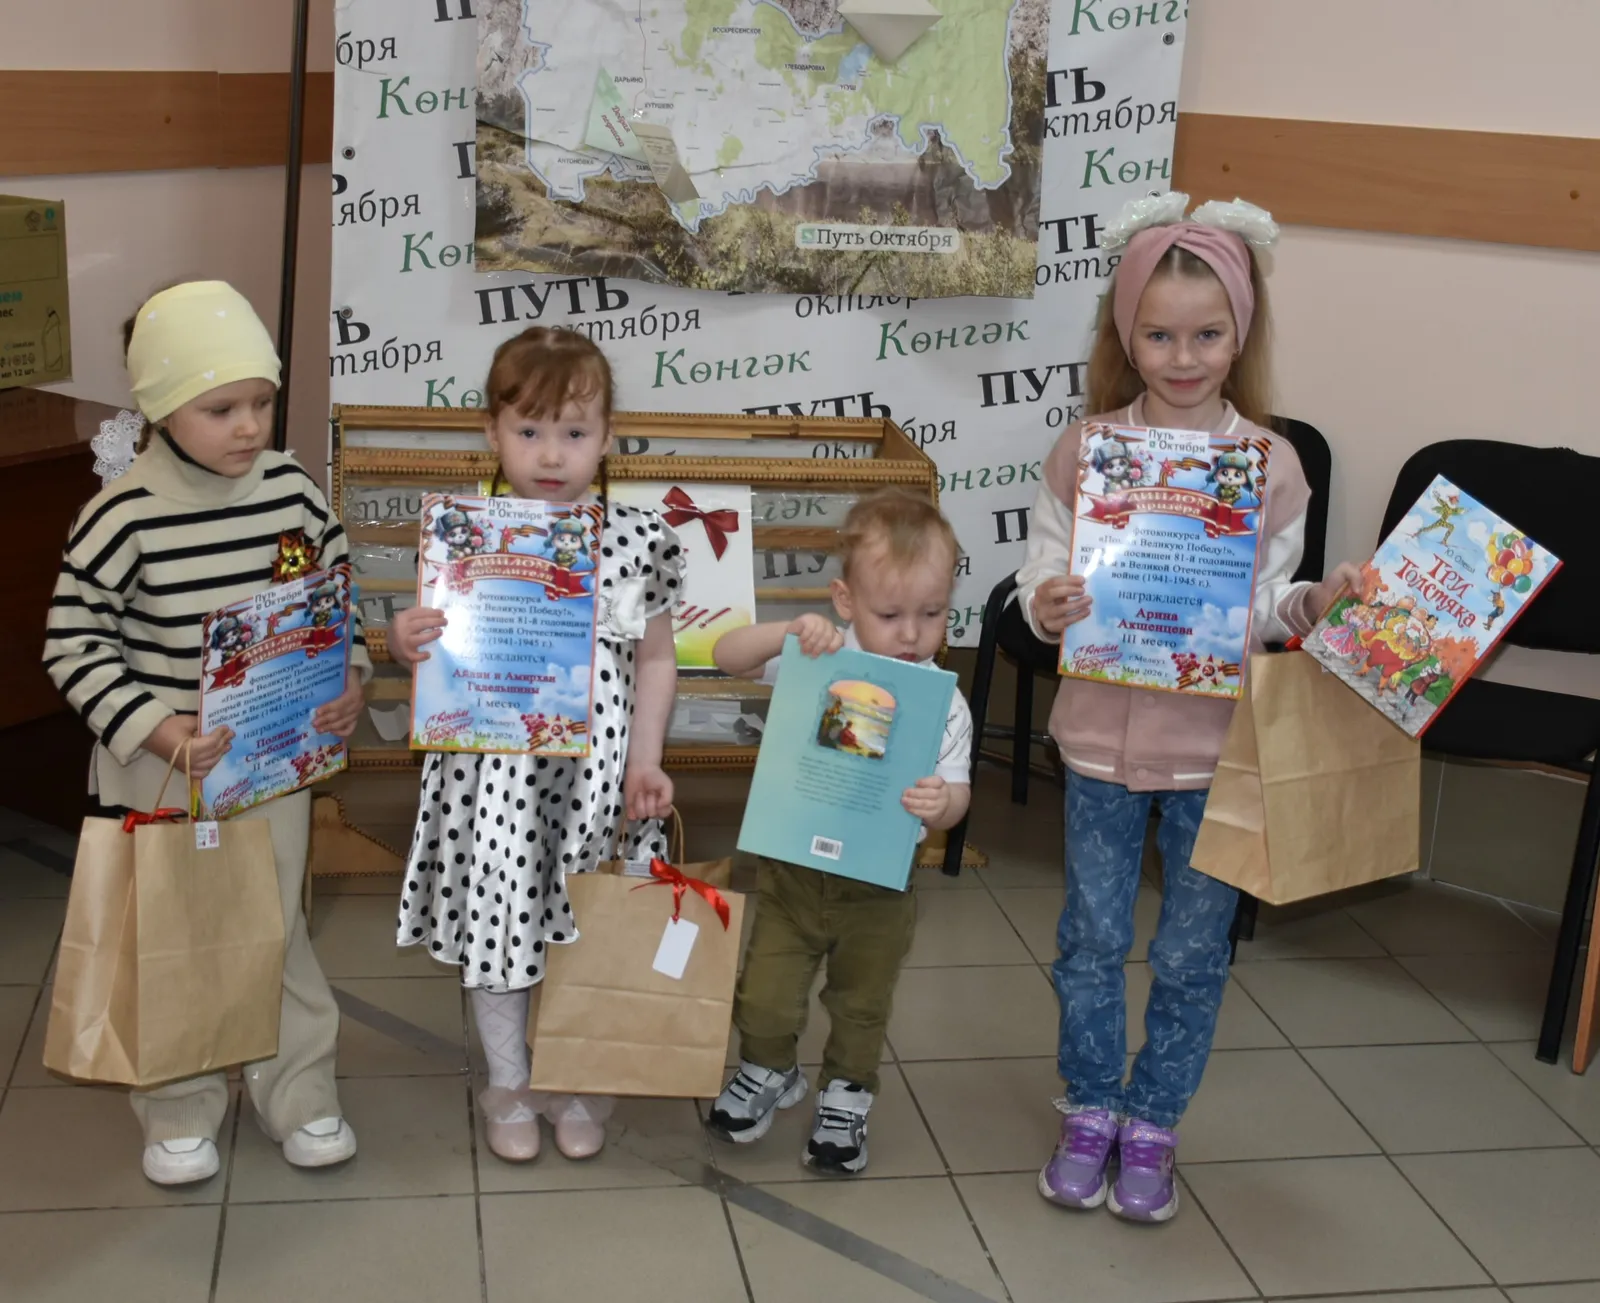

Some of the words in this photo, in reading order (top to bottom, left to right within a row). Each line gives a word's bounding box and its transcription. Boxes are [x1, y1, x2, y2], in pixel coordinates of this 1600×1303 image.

[1043, 96, 1176, 139] ктября
[817, 229, 864, 248] Путь
[869, 229, 953, 251] Октября
[474, 276, 629, 326] ПУТЬ
[876, 319, 1030, 361] Көнгәк
[651, 348, 812, 388] Көнгәк
[1148, 429, 1174, 440] Путь
[1159, 440, 1206, 454] Октября
[488, 498, 512, 509] Путь
[498, 508, 542, 521] Октября
[1140, 539, 1184, 551] Великую
[1174, 554, 1195, 563] 81-й
[1198, 557, 1252, 569] годовщине
[1129, 560, 1170, 573] Великой
[1172, 564, 1247, 579] Отечественной
[1111, 572, 1139, 581] войне
[1142, 573, 1195, 586] (1941-1945
[255, 590, 277, 603] Путь
[264, 589, 303, 609] Октября
[1118, 589, 1203, 606] награждается
[484, 603, 526, 614] Великую
[1136, 608, 1178, 621] Арина
[540, 619, 591, 629] годовщине
[1117, 618, 1193, 635] Акшенцева
[516, 628, 586, 639] Отечественной
[1122, 634, 1136, 644] III
[1140, 639, 1177, 649] место
[504, 671, 556, 684] Амирхан
[486, 700, 521, 710] место
